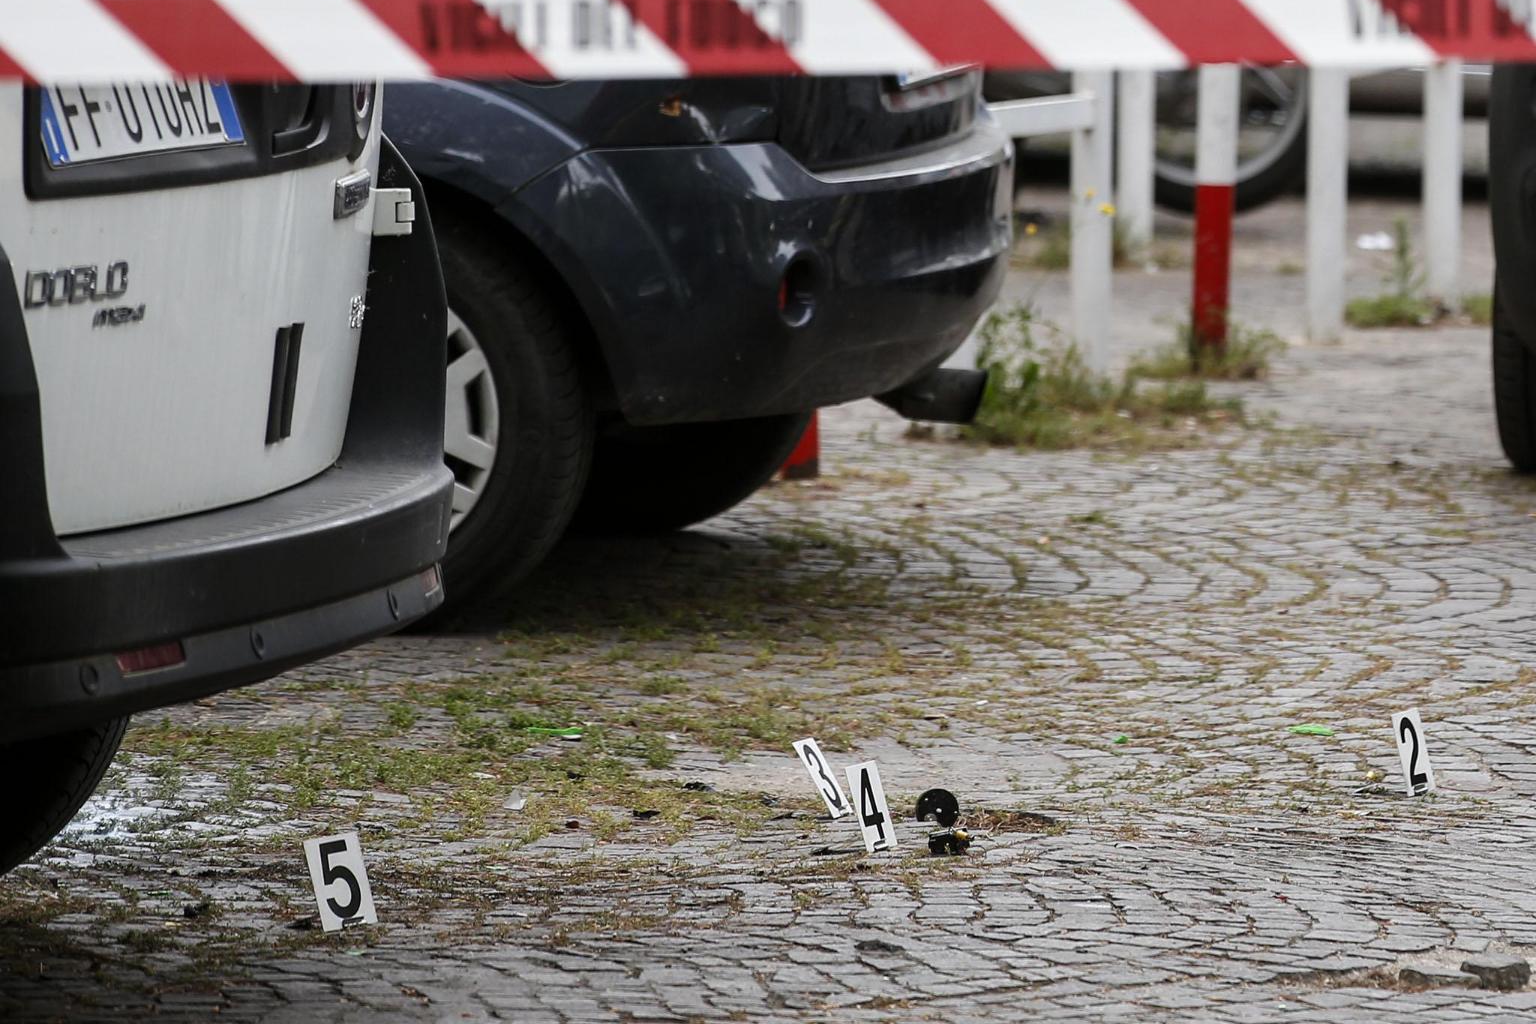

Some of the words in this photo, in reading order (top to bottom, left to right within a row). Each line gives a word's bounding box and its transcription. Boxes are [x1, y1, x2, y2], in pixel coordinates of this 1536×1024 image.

[803, 744, 842, 810] 3
[1399, 717, 1428, 787] 2
[861, 767, 885, 840] 4
[319, 839, 362, 919] 5
